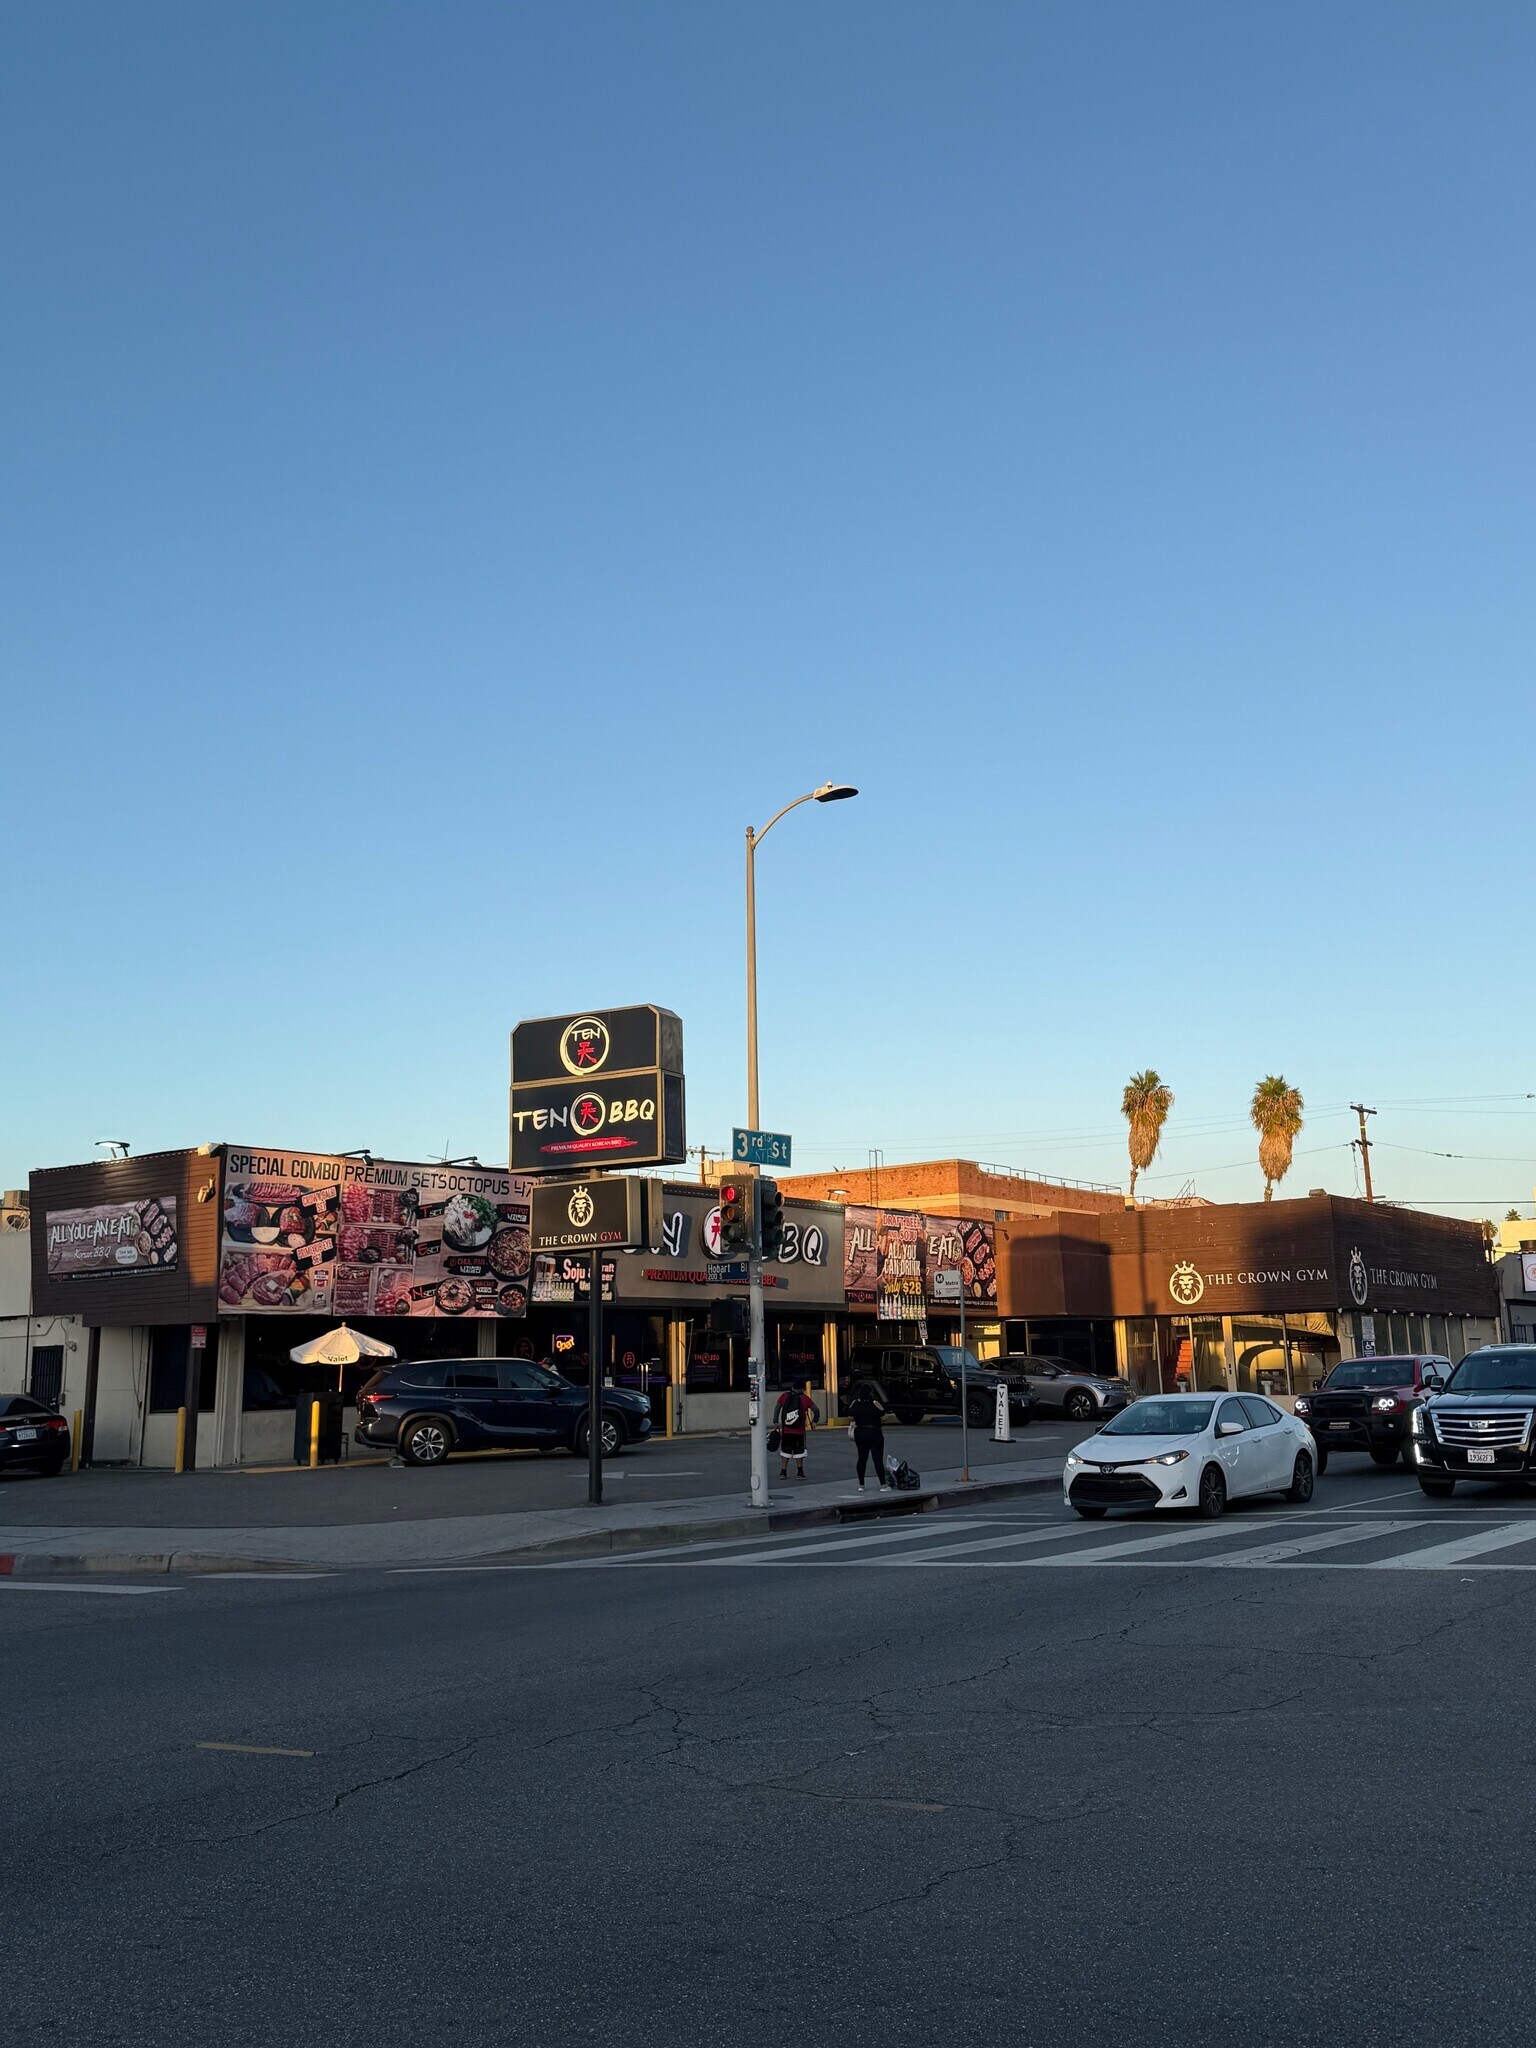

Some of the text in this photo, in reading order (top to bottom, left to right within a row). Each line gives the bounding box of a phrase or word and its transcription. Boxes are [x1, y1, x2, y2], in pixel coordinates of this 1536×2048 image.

[571, 1028, 601, 1042] TEN
[513, 1107, 568, 1132] TEN
[608, 1099, 655, 1124] BBQ
[773, 1141, 787, 1159] St
[230, 1154, 341, 1181] SPECIAL COMBO
[344, 1165, 446, 1191] PREMIUM SETS
[449, 1176, 510, 1196] OCTOPUS
[50, 1215, 133, 1253] ALL YOU CAN EAT
[538, 1231, 622, 1247] THE CROWN GYM
[849, 1226, 876, 1263] ALL
[889, 1244, 917, 1260] ALL YOU
[930, 1234, 956, 1267] EAT
[562, 1258, 586, 1284] Soju
[602, 1264, 615, 1274] raft
[602, 1273, 614, 1282] eer
[646, 1269, 688, 1283] PREMIUM
[707, 1262, 748, 1275] Hobart Bl
[1206, 1269, 1329, 1286] THE CROWN GYM
[902, 1280, 922, 1296] $28
[1370, 1268, 1439, 1290] THE CROWN GYM
